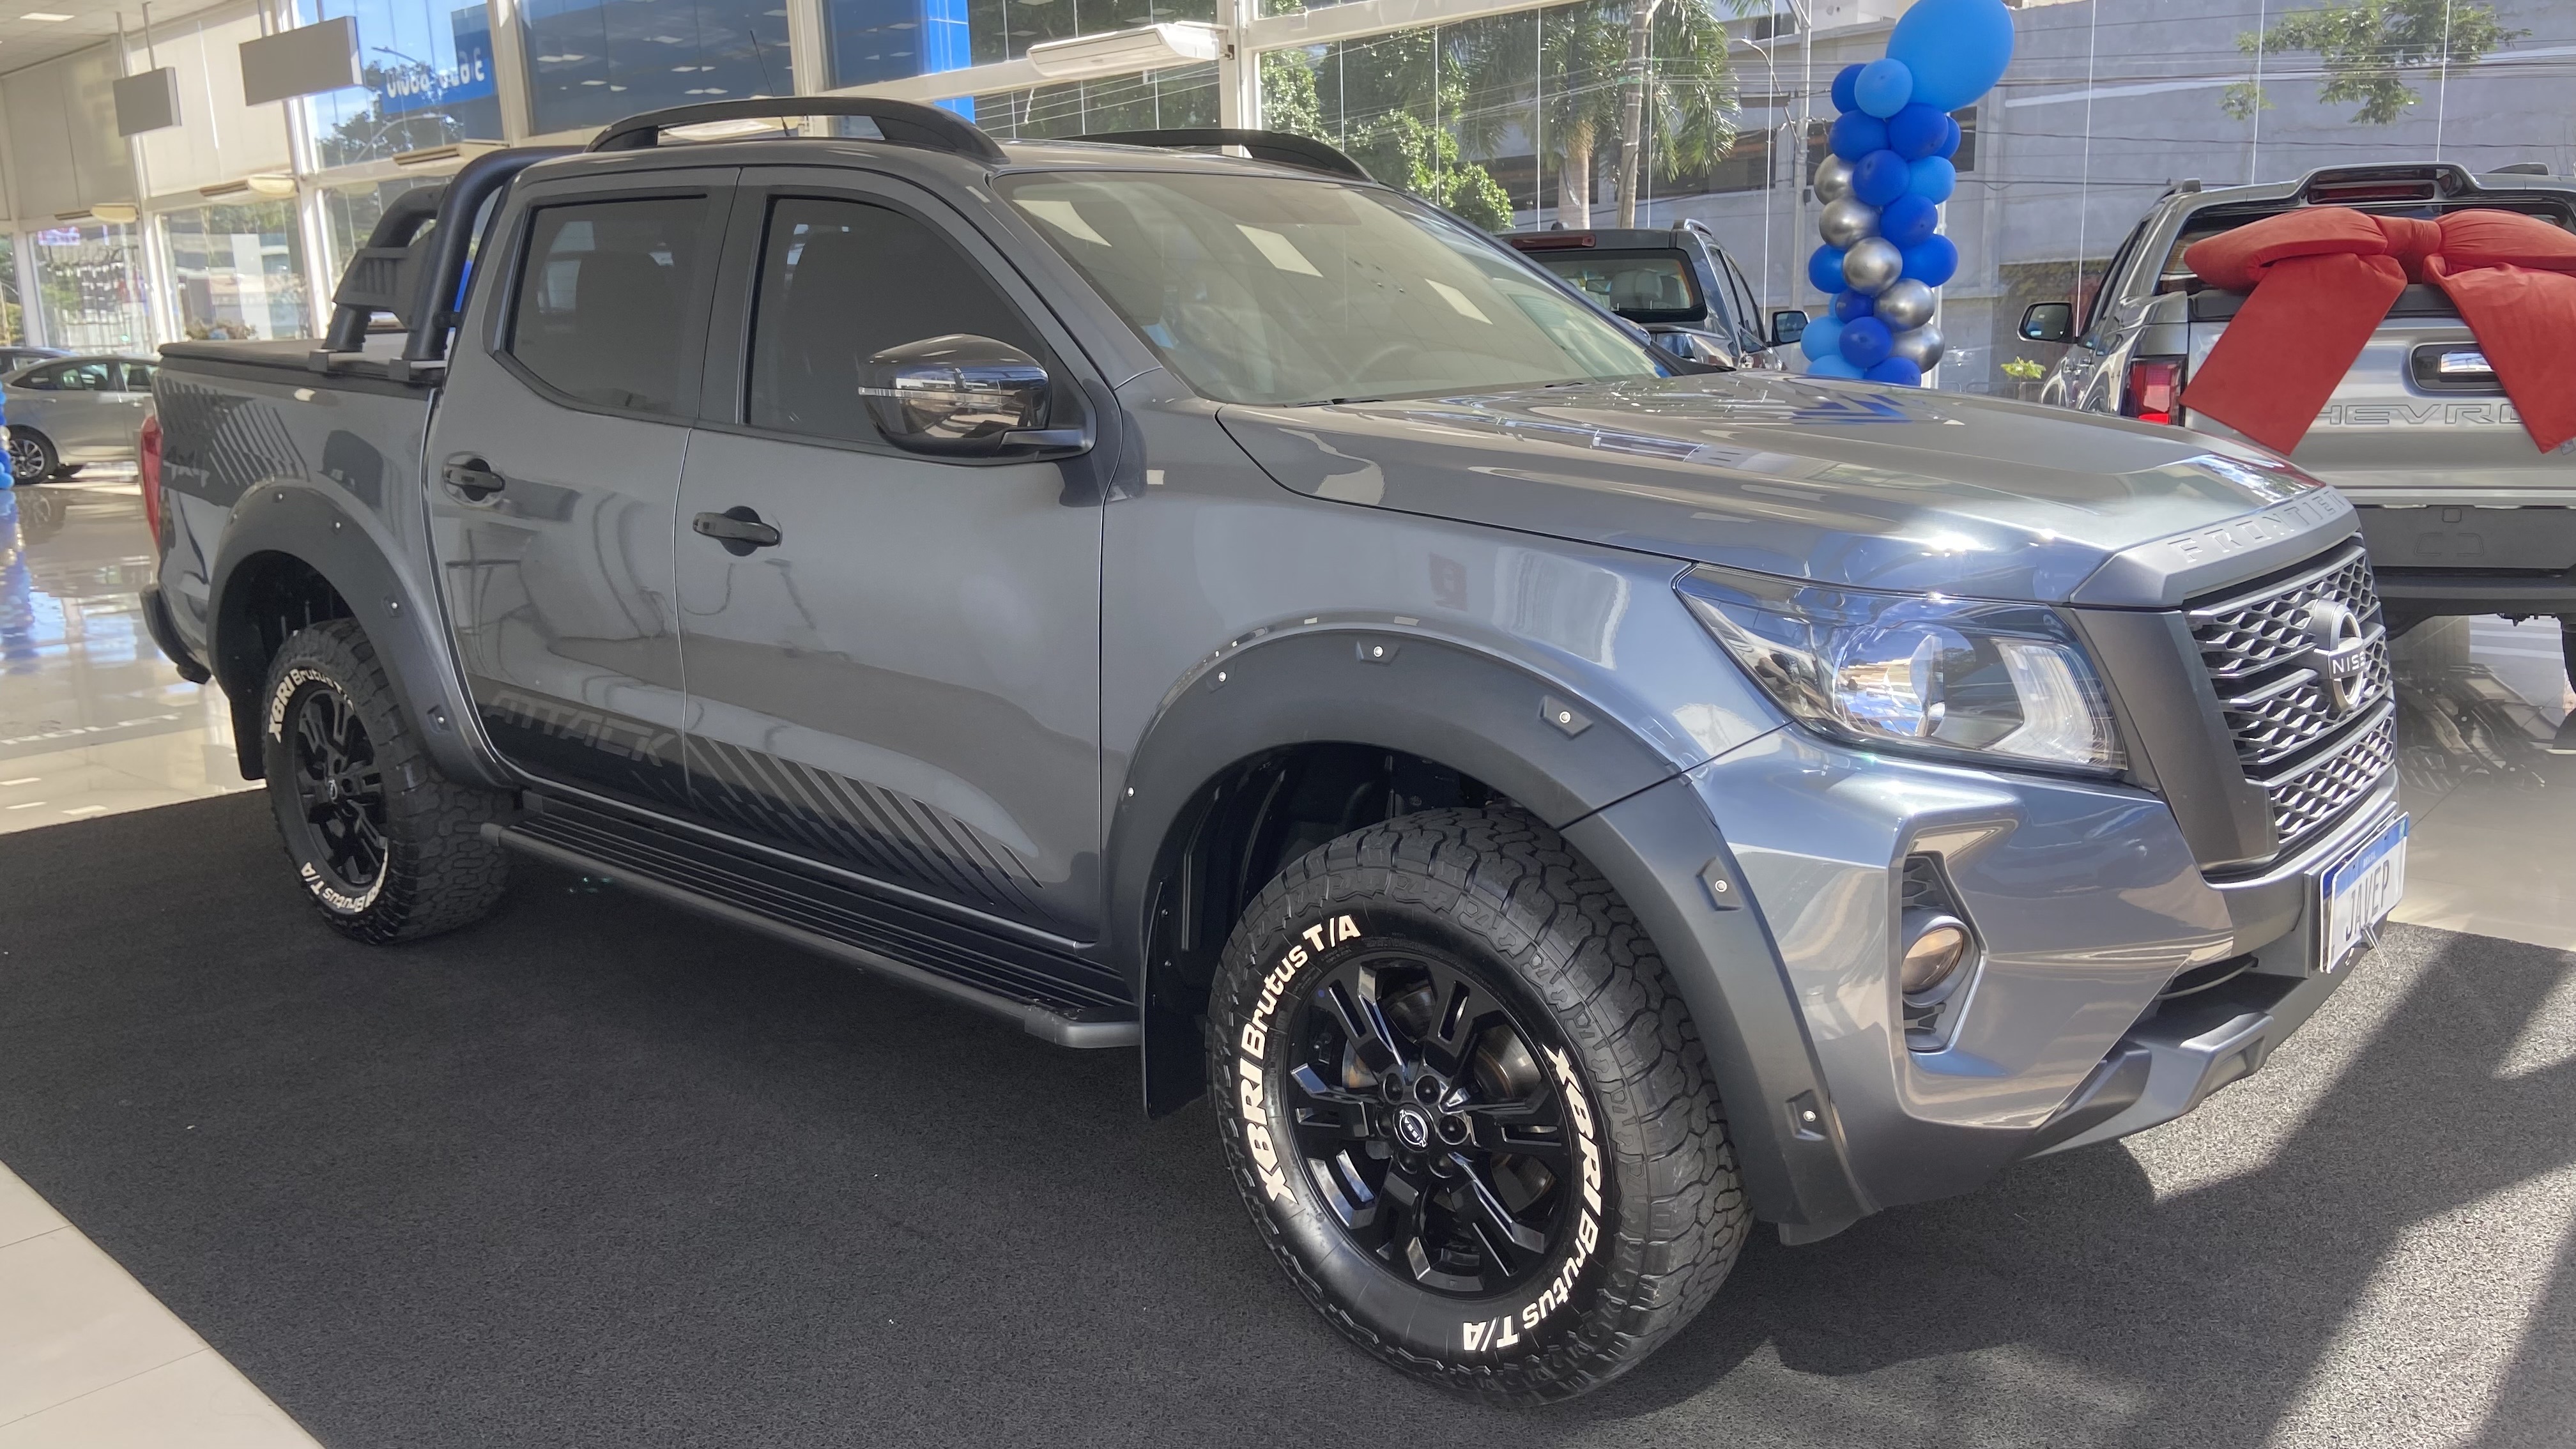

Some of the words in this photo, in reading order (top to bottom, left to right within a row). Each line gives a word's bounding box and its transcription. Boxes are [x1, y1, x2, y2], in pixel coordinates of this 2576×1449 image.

[2166, 490, 2346, 564] FRONTIER
[268, 675, 295, 744] XBRI
[289, 668, 335, 689] Brutus
[482, 690, 676, 768] ATTACK
[300, 862, 325, 896] T/A
[323, 887, 366, 914] Brutus
[2345, 859, 2389, 942] JAVEP
[1302, 914, 1361, 952] T/A
[1241, 945, 1308, 1060] Brutus
[1239, 1057, 1300, 1204] XBRI
[1399, 1108, 1427, 1148] NISSAN
[1542, 1041, 1602, 1217] XBRI
[1522, 1208, 1599, 1330] Brutus
[1462, 1315, 1519, 1352] T/A
